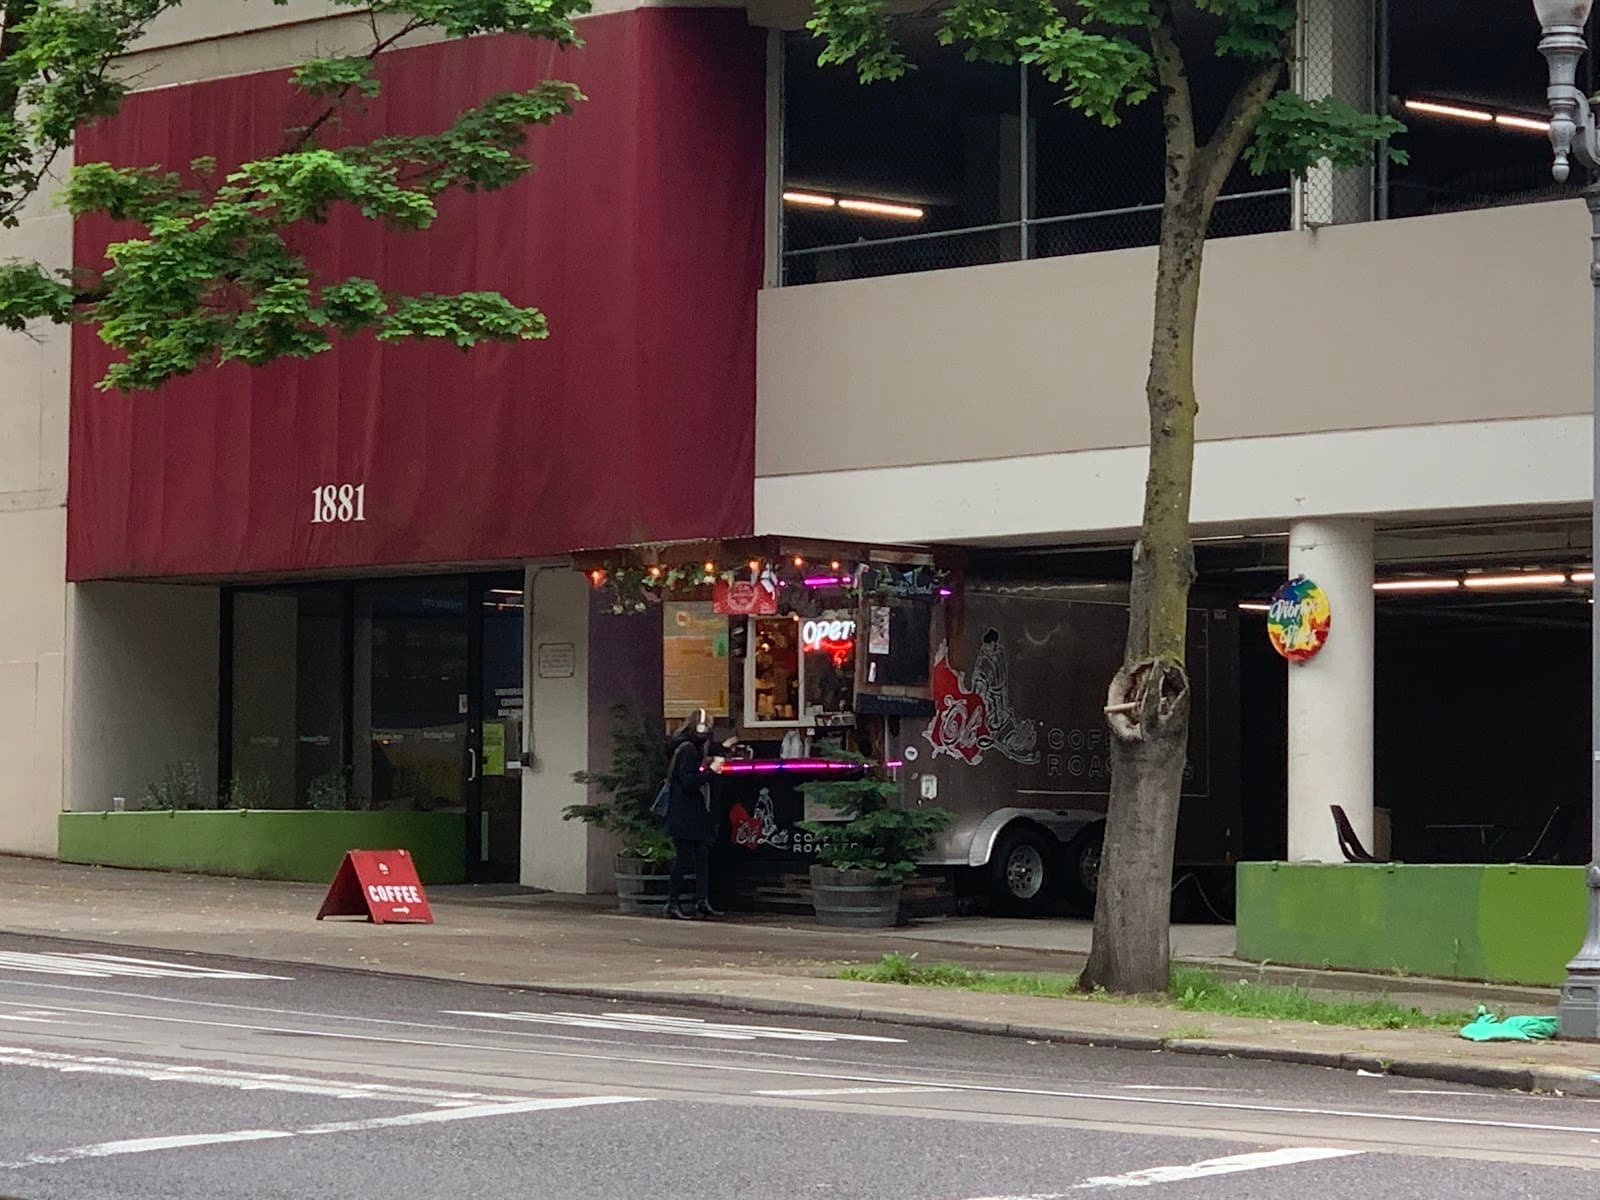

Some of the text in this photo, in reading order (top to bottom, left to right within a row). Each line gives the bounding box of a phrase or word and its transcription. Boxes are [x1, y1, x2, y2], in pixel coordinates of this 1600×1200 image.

[311, 483, 366, 524] 1881
[803, 620, 855, 650] Open
[1047, 727, 1108, 750] COF
[368, 885, 422, 903] COFFEE
